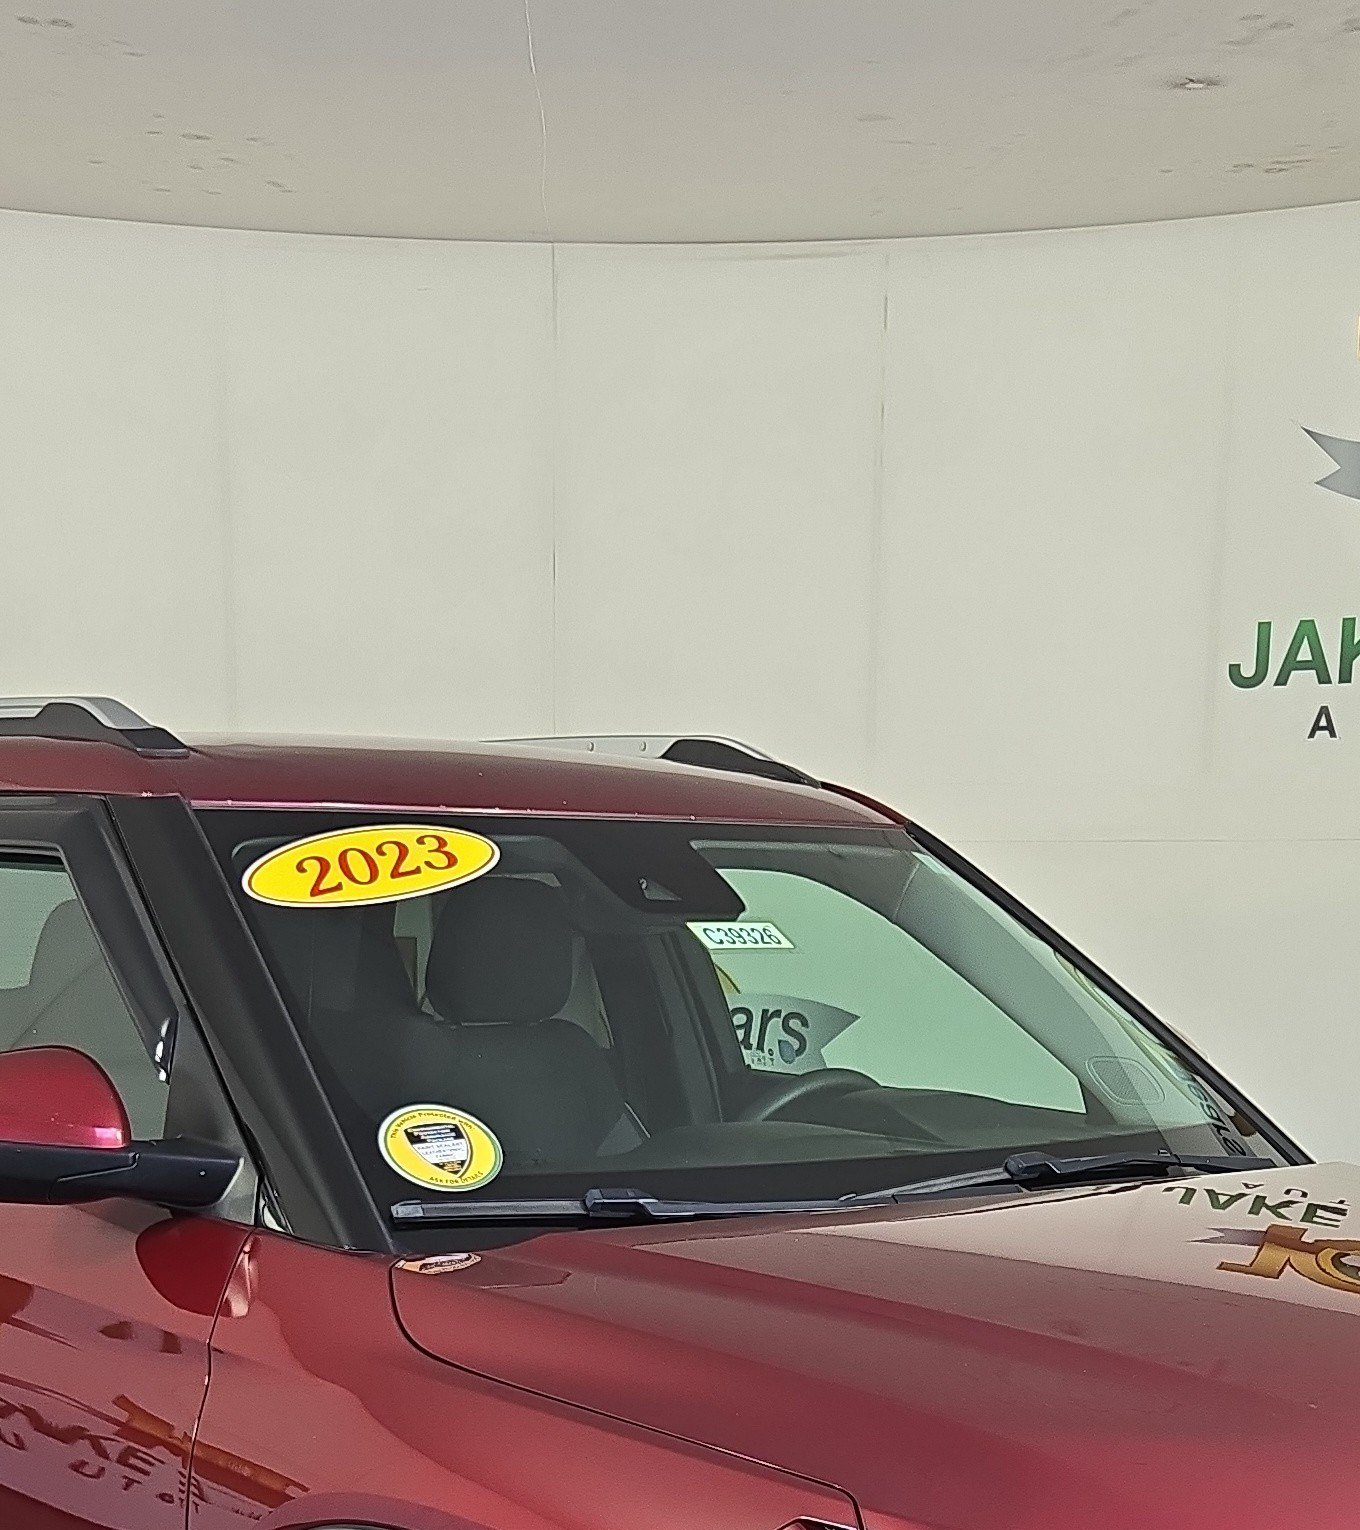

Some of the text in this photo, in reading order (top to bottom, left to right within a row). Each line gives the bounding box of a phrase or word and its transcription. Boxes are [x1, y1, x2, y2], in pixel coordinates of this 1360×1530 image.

[296, 835, 458, 897] 2023
[703, 927, 782, 945] C39326
[729, 1006, 809, 1058] ars
